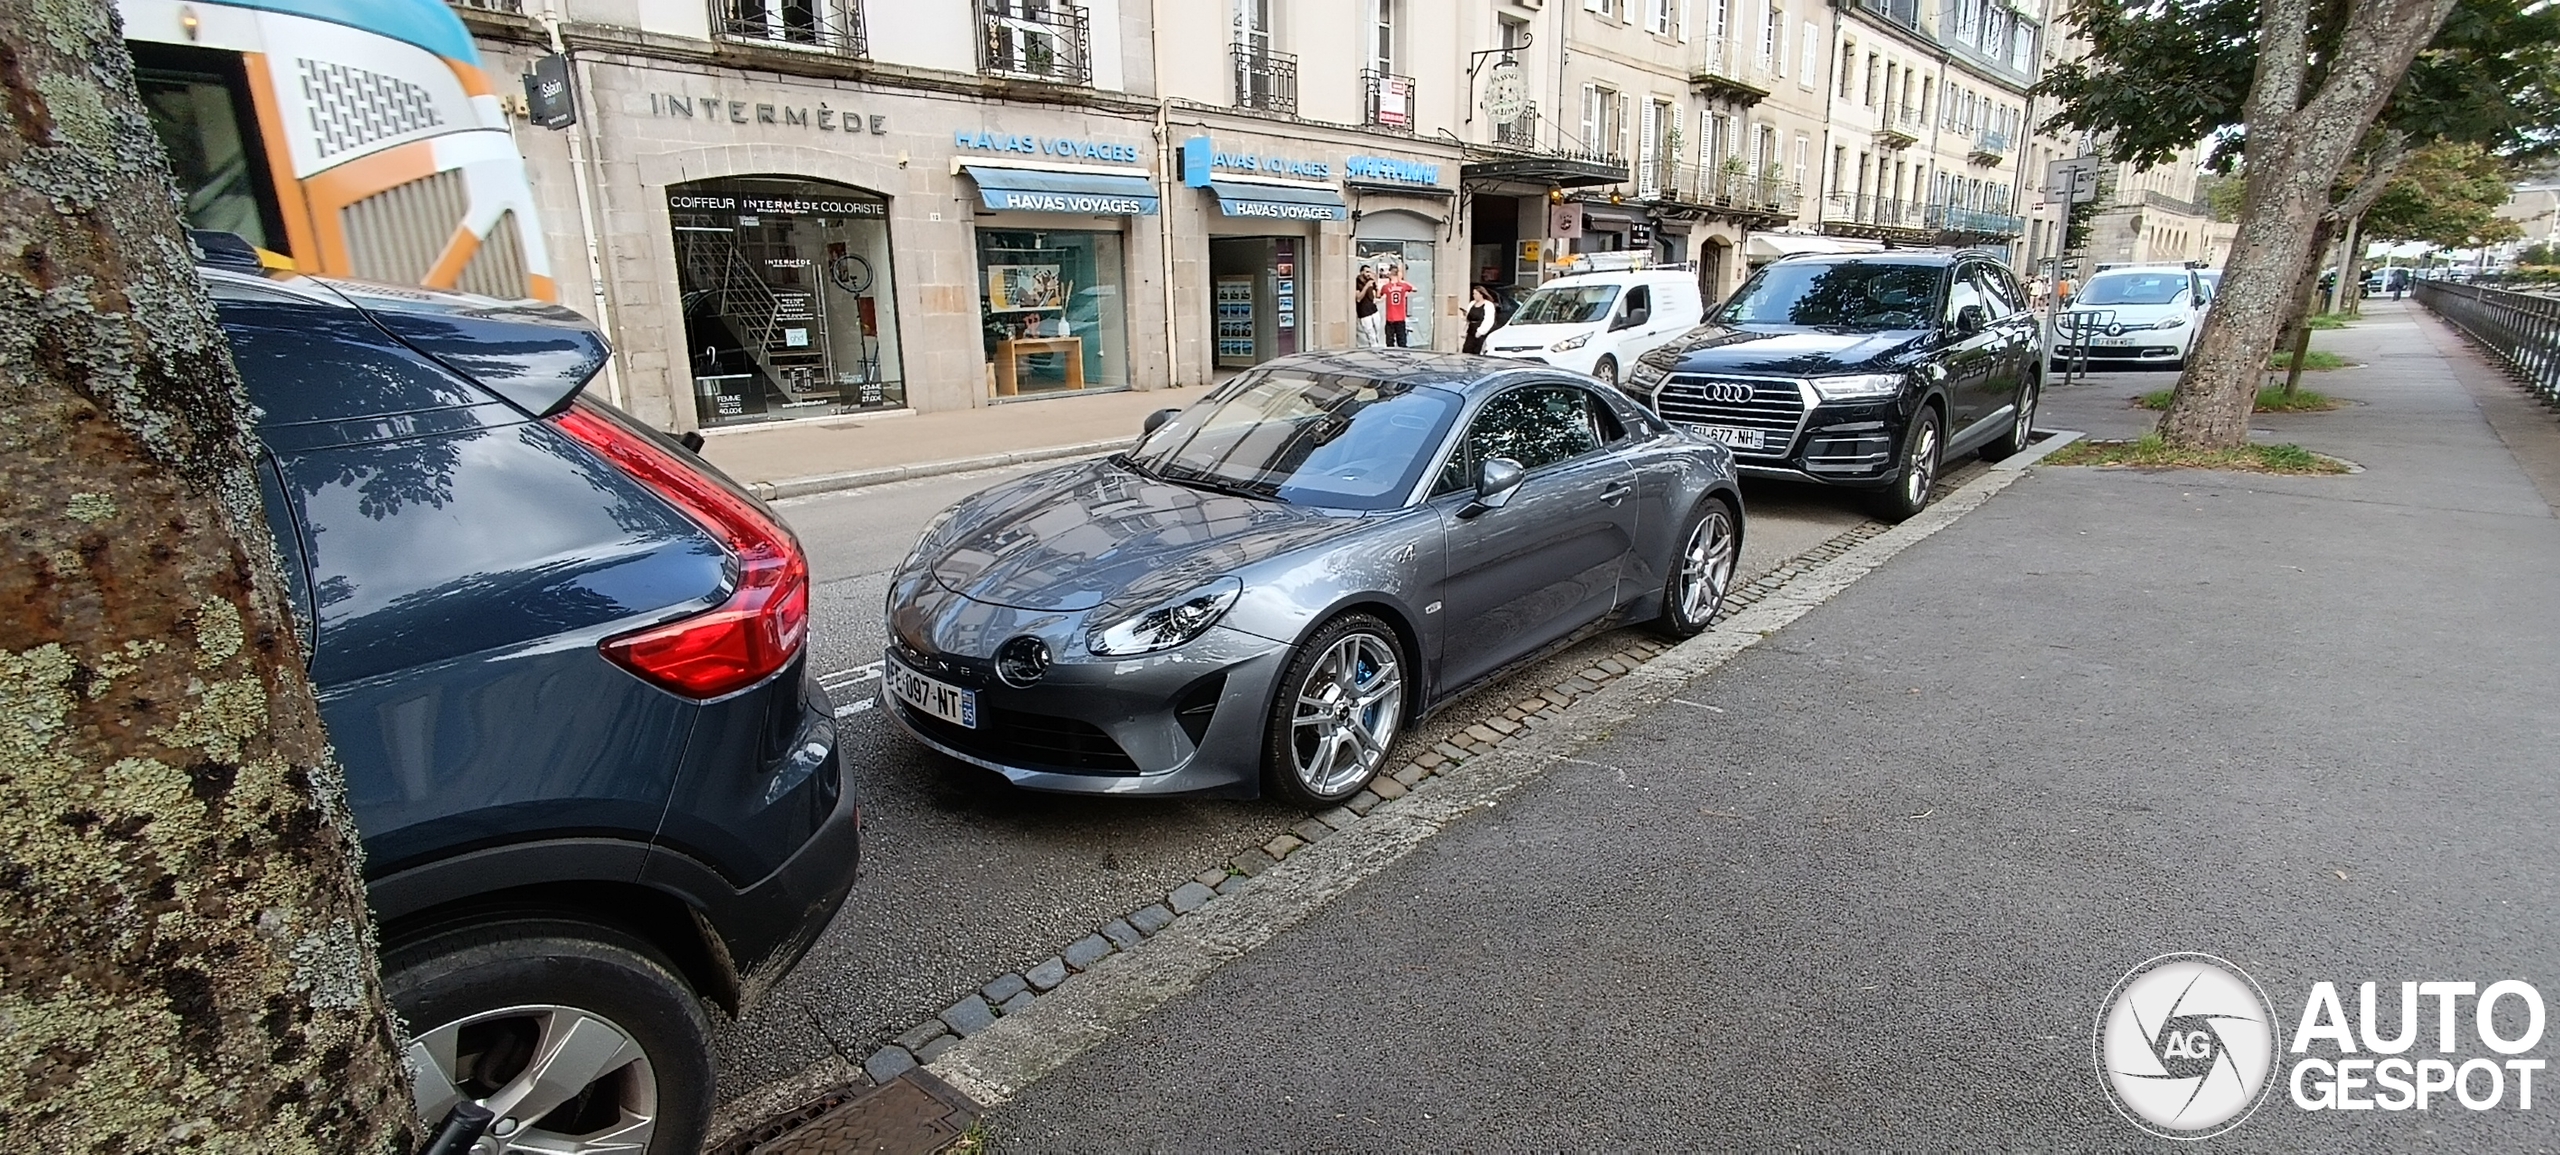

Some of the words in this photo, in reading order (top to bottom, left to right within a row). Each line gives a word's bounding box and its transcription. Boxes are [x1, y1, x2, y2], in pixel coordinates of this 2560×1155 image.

[650, 92, 887, 136] INTERMÈDE
[954, 129, 1035, 155] HAVAS
[1041, 136, 1139, 163] VOYAGES
[1211, 152, 1257, 171] AVAS
[1258, 155, 1331, 178] VOYAGES
[670, 196, 736, 210] COIFFEUR
[743, 198, 819, 211] INTERMÈDE
[820, 201, 885, 215] COLORISTE
[1006, 193, 1066, 211] HAVAS
[1067, 196, 1140, 214] VOYAGES
[1236, 202, 1278, 218] HAVAS
[1280, 204, 1333, 220] VOYAGES
[1391, 291, 1401, 306] 8
[962, 706, 975, 723] 35
